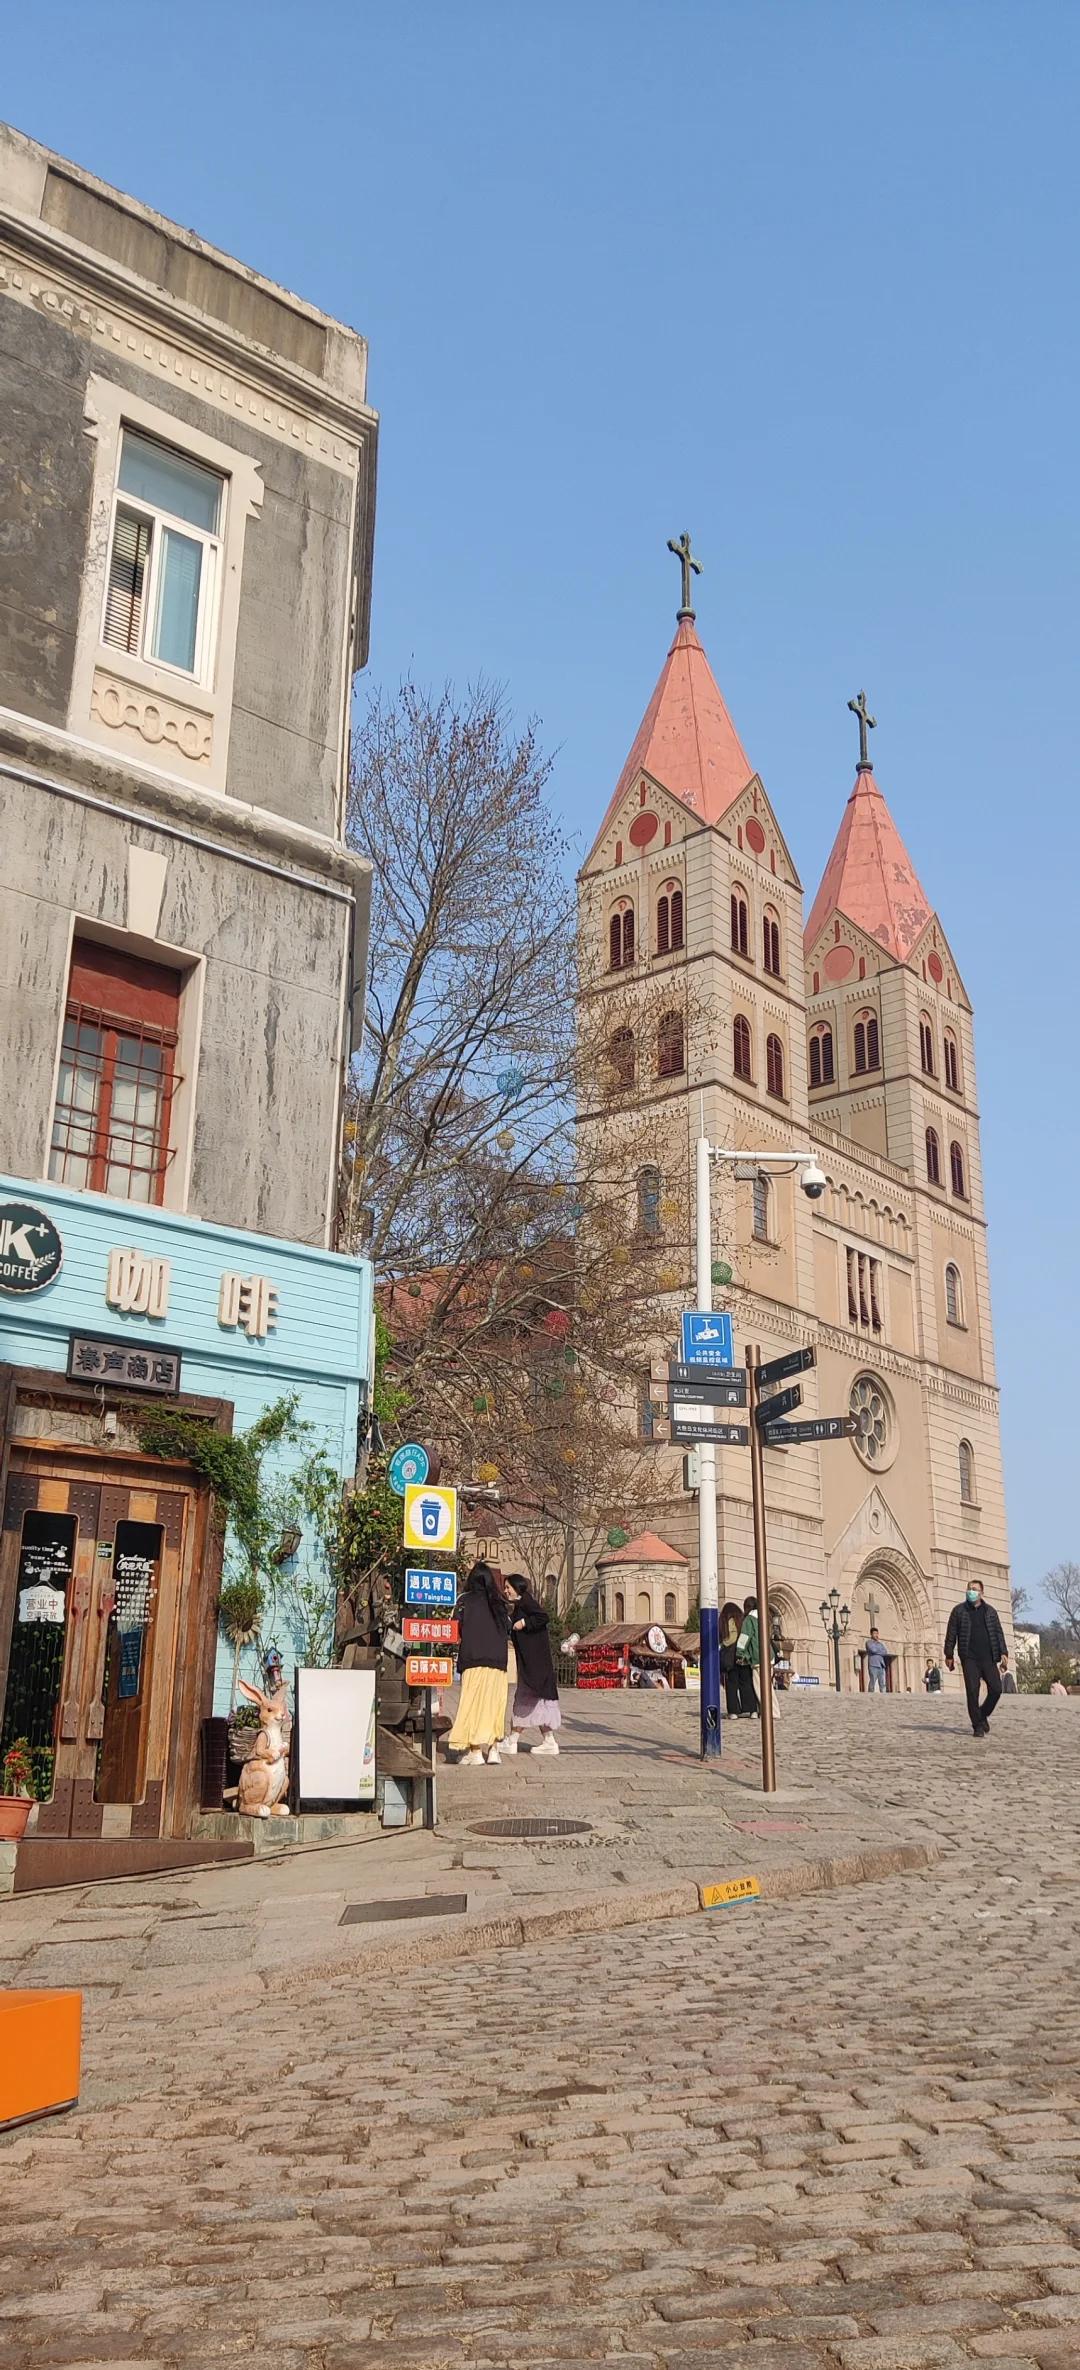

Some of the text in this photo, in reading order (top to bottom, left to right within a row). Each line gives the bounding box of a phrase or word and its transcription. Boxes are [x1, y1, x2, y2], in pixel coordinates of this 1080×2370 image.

[105, 1247, 280, 1339] 咖啡
[695, 1349, 721, 1357] 公共安全
[76, 1347, 174, 1385] 春声商店
[409, 1575, 453, 1592] 遇见青岛
[26, 1598, 58, 1610] 营业中
[410, 1592, 451, 1602] I Tsingtao
[409, 1622, 452, 1639] 喝杯咖啡
[410, 1660, 448, 1674] 日落大道
